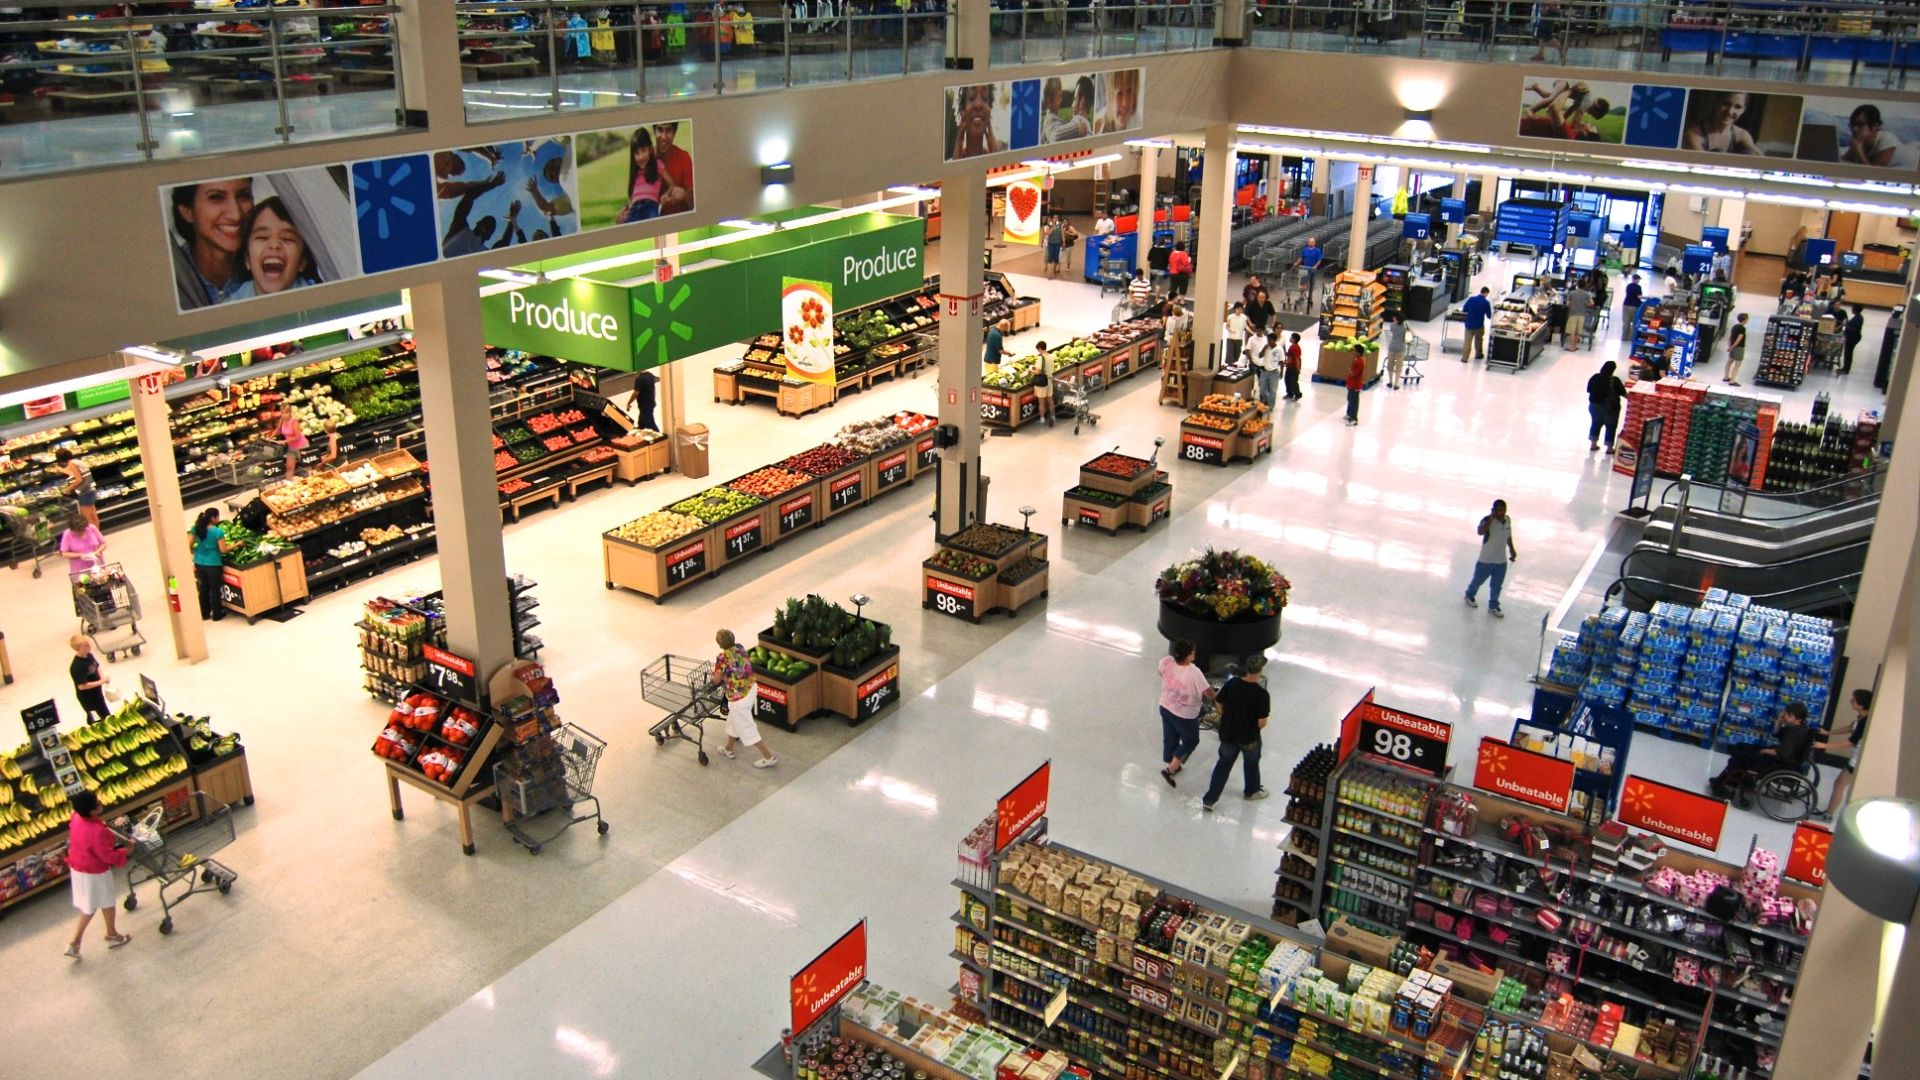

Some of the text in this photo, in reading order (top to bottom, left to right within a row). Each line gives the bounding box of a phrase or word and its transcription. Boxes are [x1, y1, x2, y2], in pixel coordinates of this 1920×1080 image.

[1441, 212, 1450, 220] 18
[1417, 229, 1426, 238] 17
[1567, 226, 1576, 234] 20
[843, 246, 917, 286] Produce
[1700, 262, 1710, 272] 21
[510, 291, 618, 341] Produce
[1191, 436, 1223, 448] Unbeatable
[673, 543, 703, 561] Unbeatable
[936, 580, 972, 596] Unbeatable
[434, 649, 467, 669] Unbeatable
[1381, 710, 1446, 737] Unbeatable
[1496, 777, 1564, 805] Unbeatable
[1009, 800, 1046, 836] Unbeatable
[1641, 815, 1714, 844] Unbeatable
[811, 965, 863, 1014] Unbeatable
